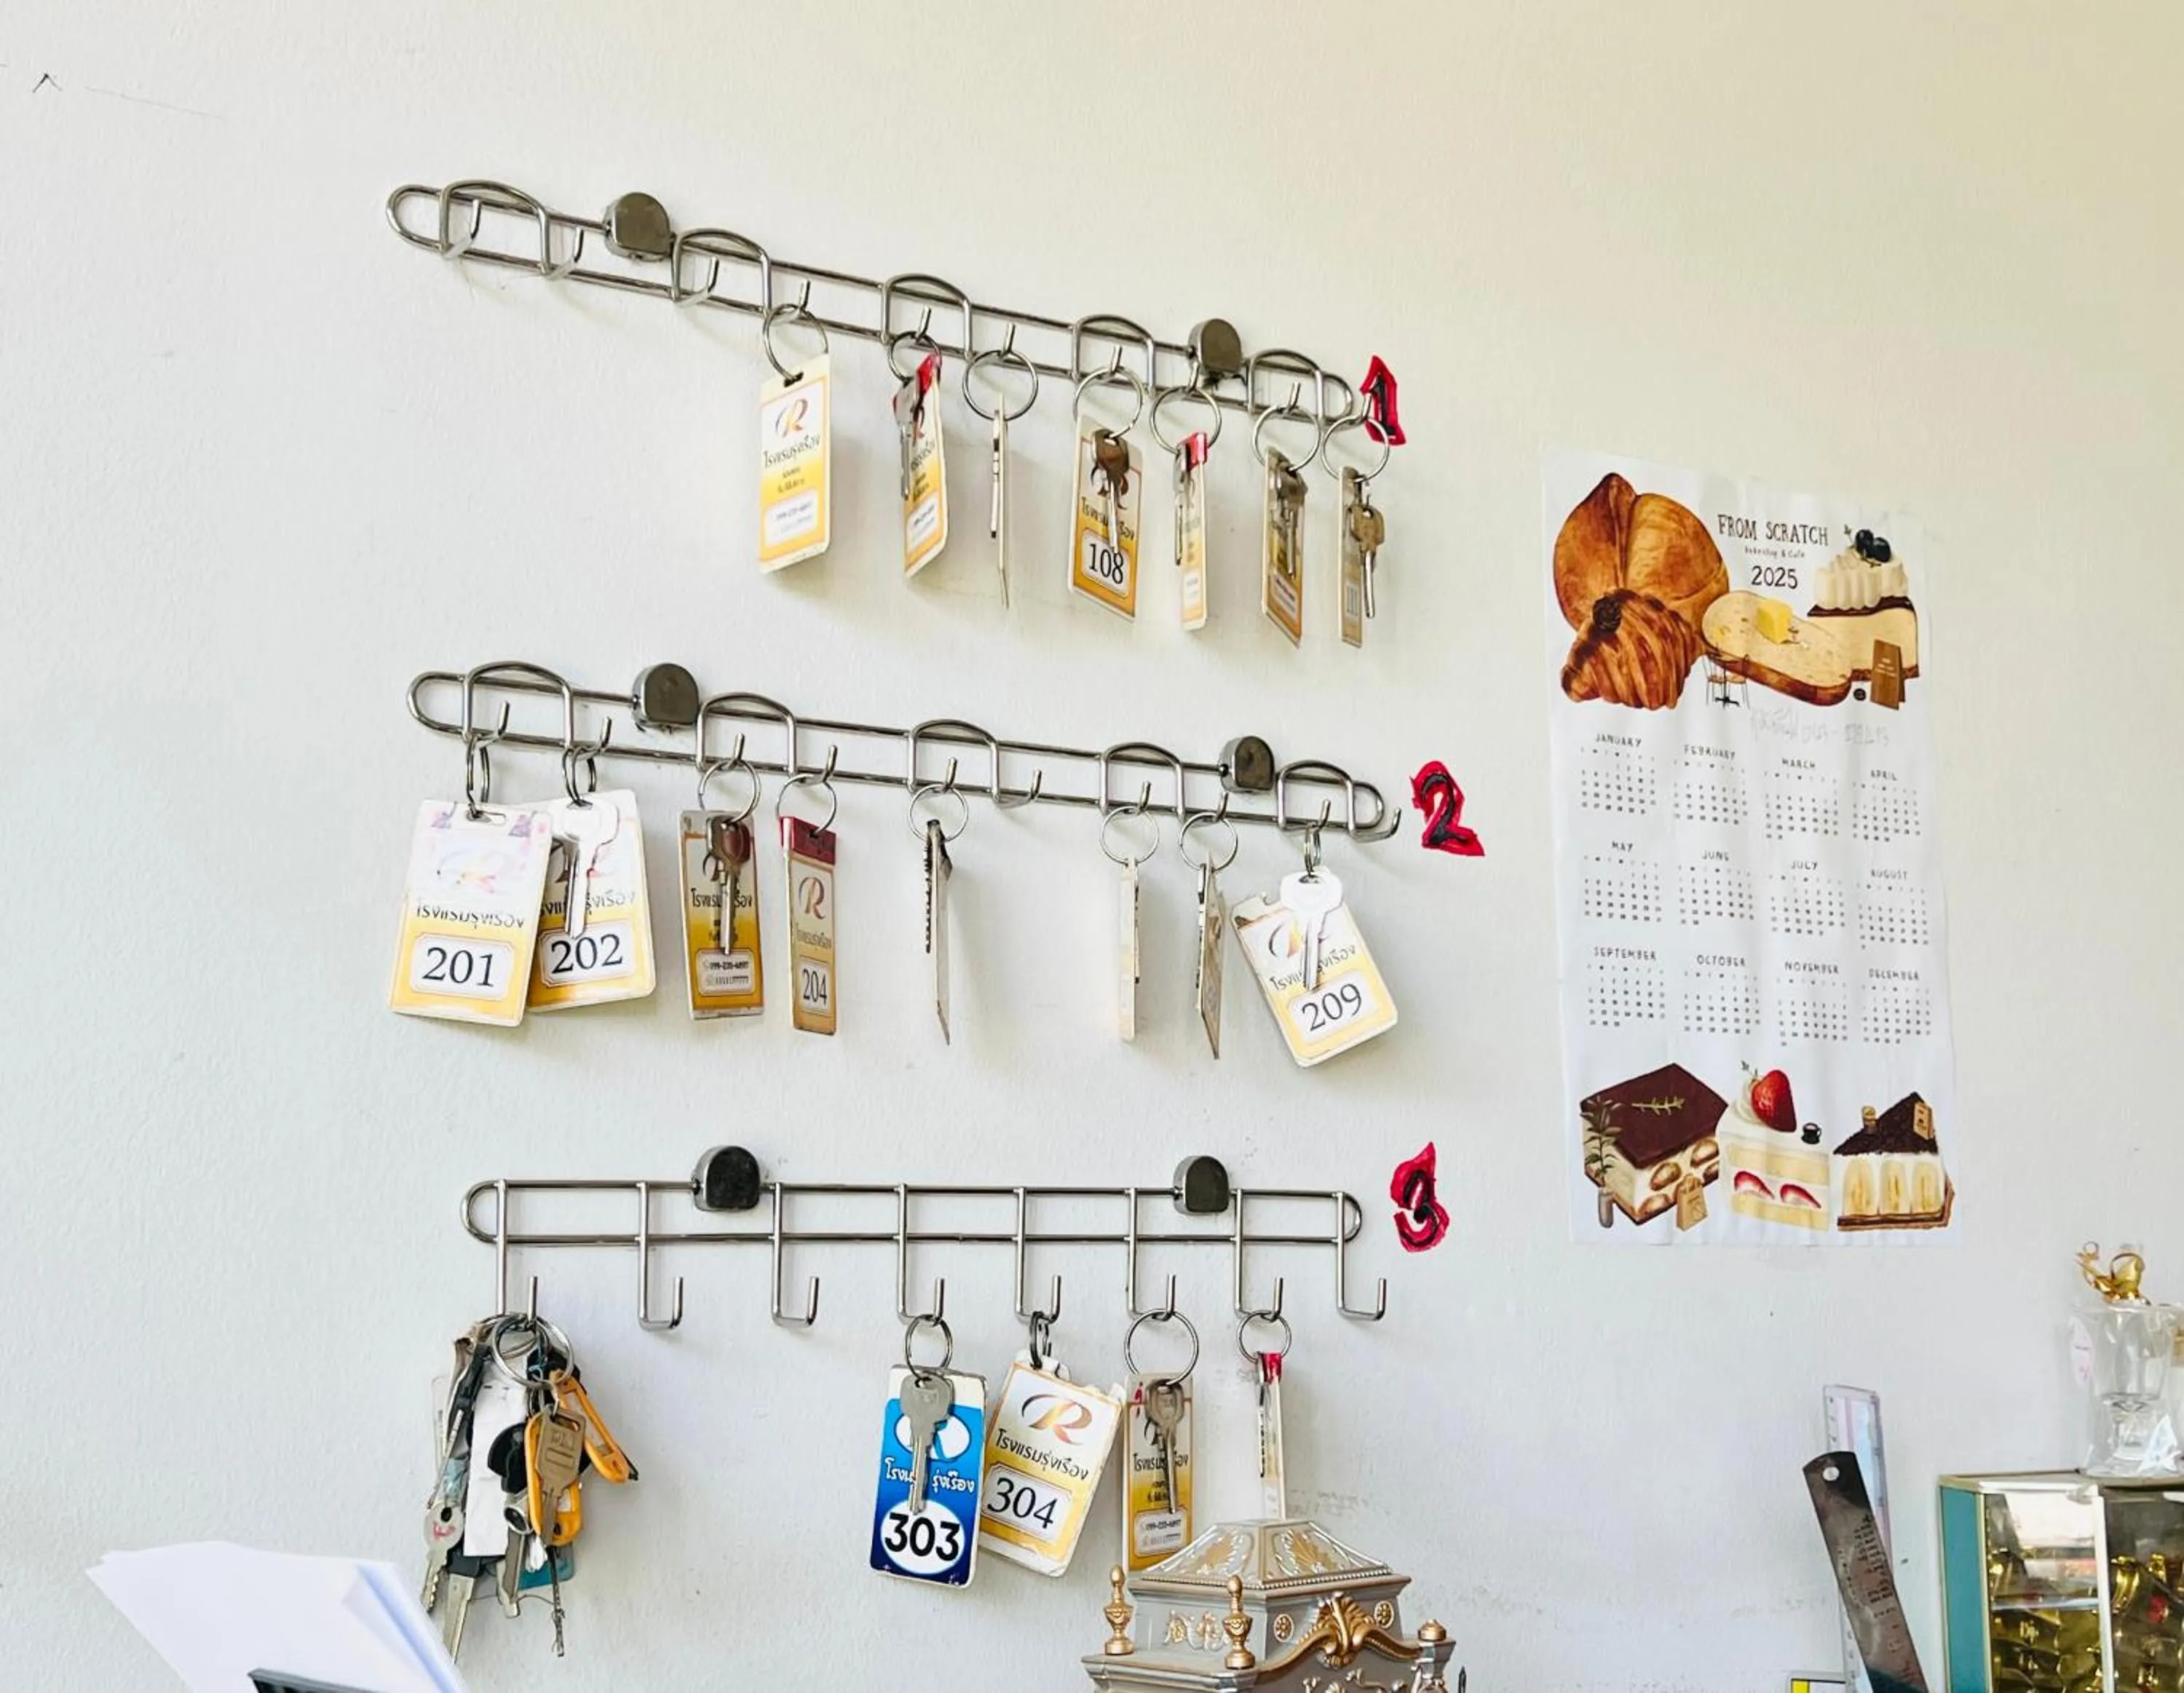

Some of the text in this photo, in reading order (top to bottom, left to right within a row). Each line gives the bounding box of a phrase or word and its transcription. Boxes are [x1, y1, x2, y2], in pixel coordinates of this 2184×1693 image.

[1717, 514, 1828, 546] FROM SCRATCH
[1089, 544, 1123, 584] 108
[1751, 566, 1798, 589] 2025
[1596, 733, 1642, 748] JANUARY
[1684, 745, 1736, 760] FEBRUARY
[1782, 758, 1816, 769] MARCH
[1870, 769, 1898, 781] APRIL
[1409, 761, 1485, 856] 2
[1611, 841, 1633, 852] MAY
[1701, 850, 1729, 862] JUNE
[1791, 861, 1818, 871] JULY
[1871, 869, 1907, 881] AUGUST
[551, 934, 623, 974] 202
[1594, 946, 1657, 961] SEPTEMBER
[1696, 954, 1745, 967] OCTOBER
[422, 947, 494, 987] 201
[1784, 962, 1839, 975] NOVEMBER
[1869, 968, 1920, 981] DECEMBER
[802, 969, 827, 1005] 204
[1302, 983, 1362, 1031] 209
[986, 1477, 1059, 1529] 304
[885, 1512, 960, 1562] 303
